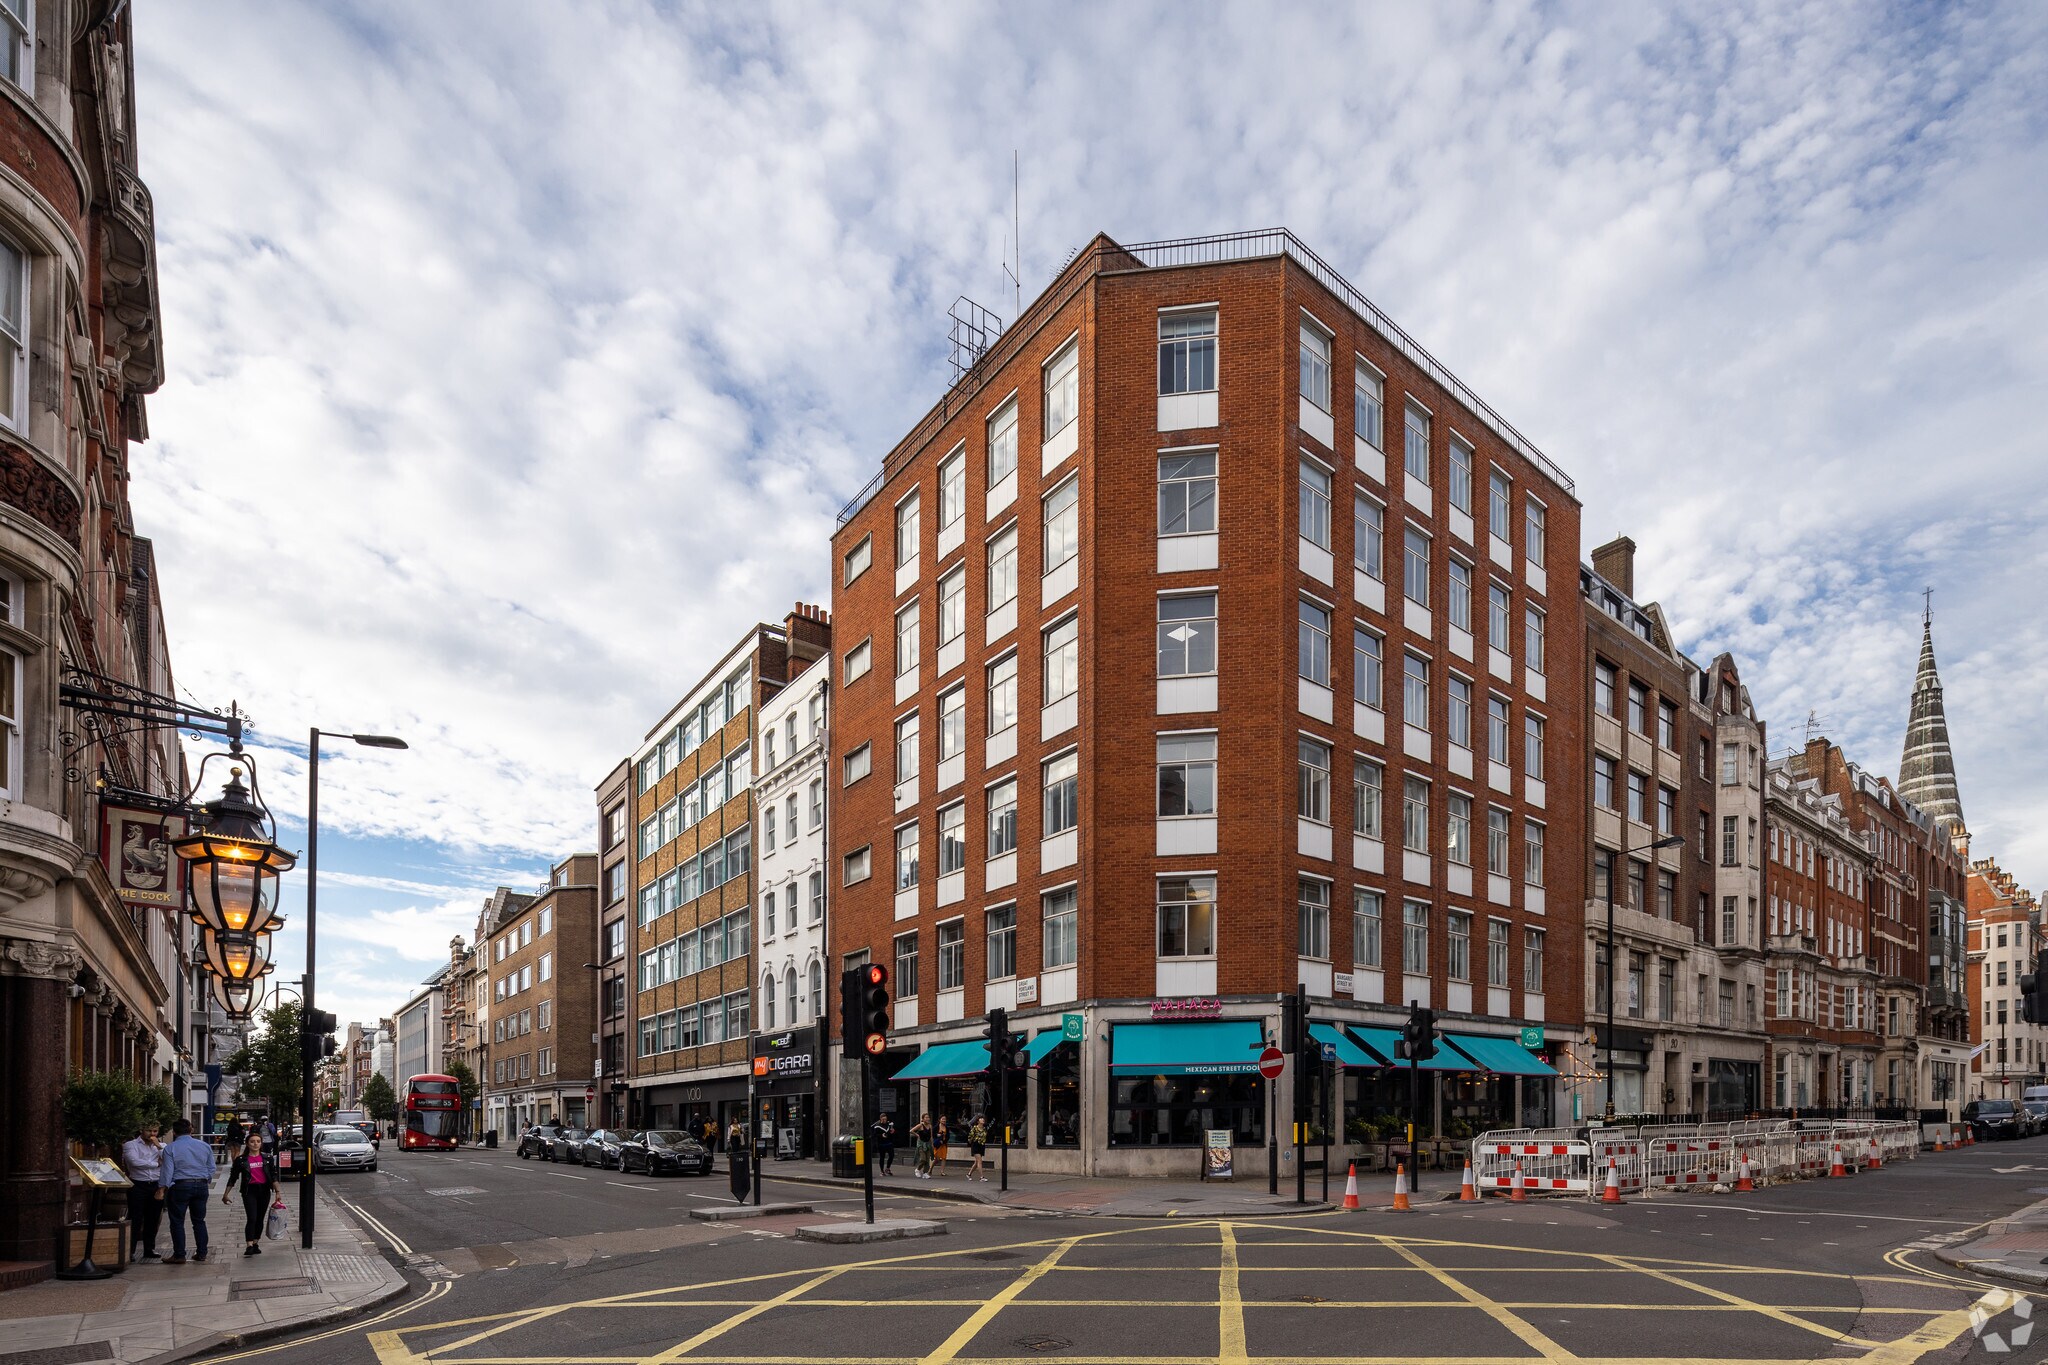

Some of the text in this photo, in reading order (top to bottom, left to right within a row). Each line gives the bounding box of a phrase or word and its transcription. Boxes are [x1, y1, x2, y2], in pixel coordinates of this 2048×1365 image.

[116, 889, 172, 902] HE COCK
[1151, 999, 1222, 1011] WAHACA
[1185, 1065, 1217, 1073] MEXICAN
